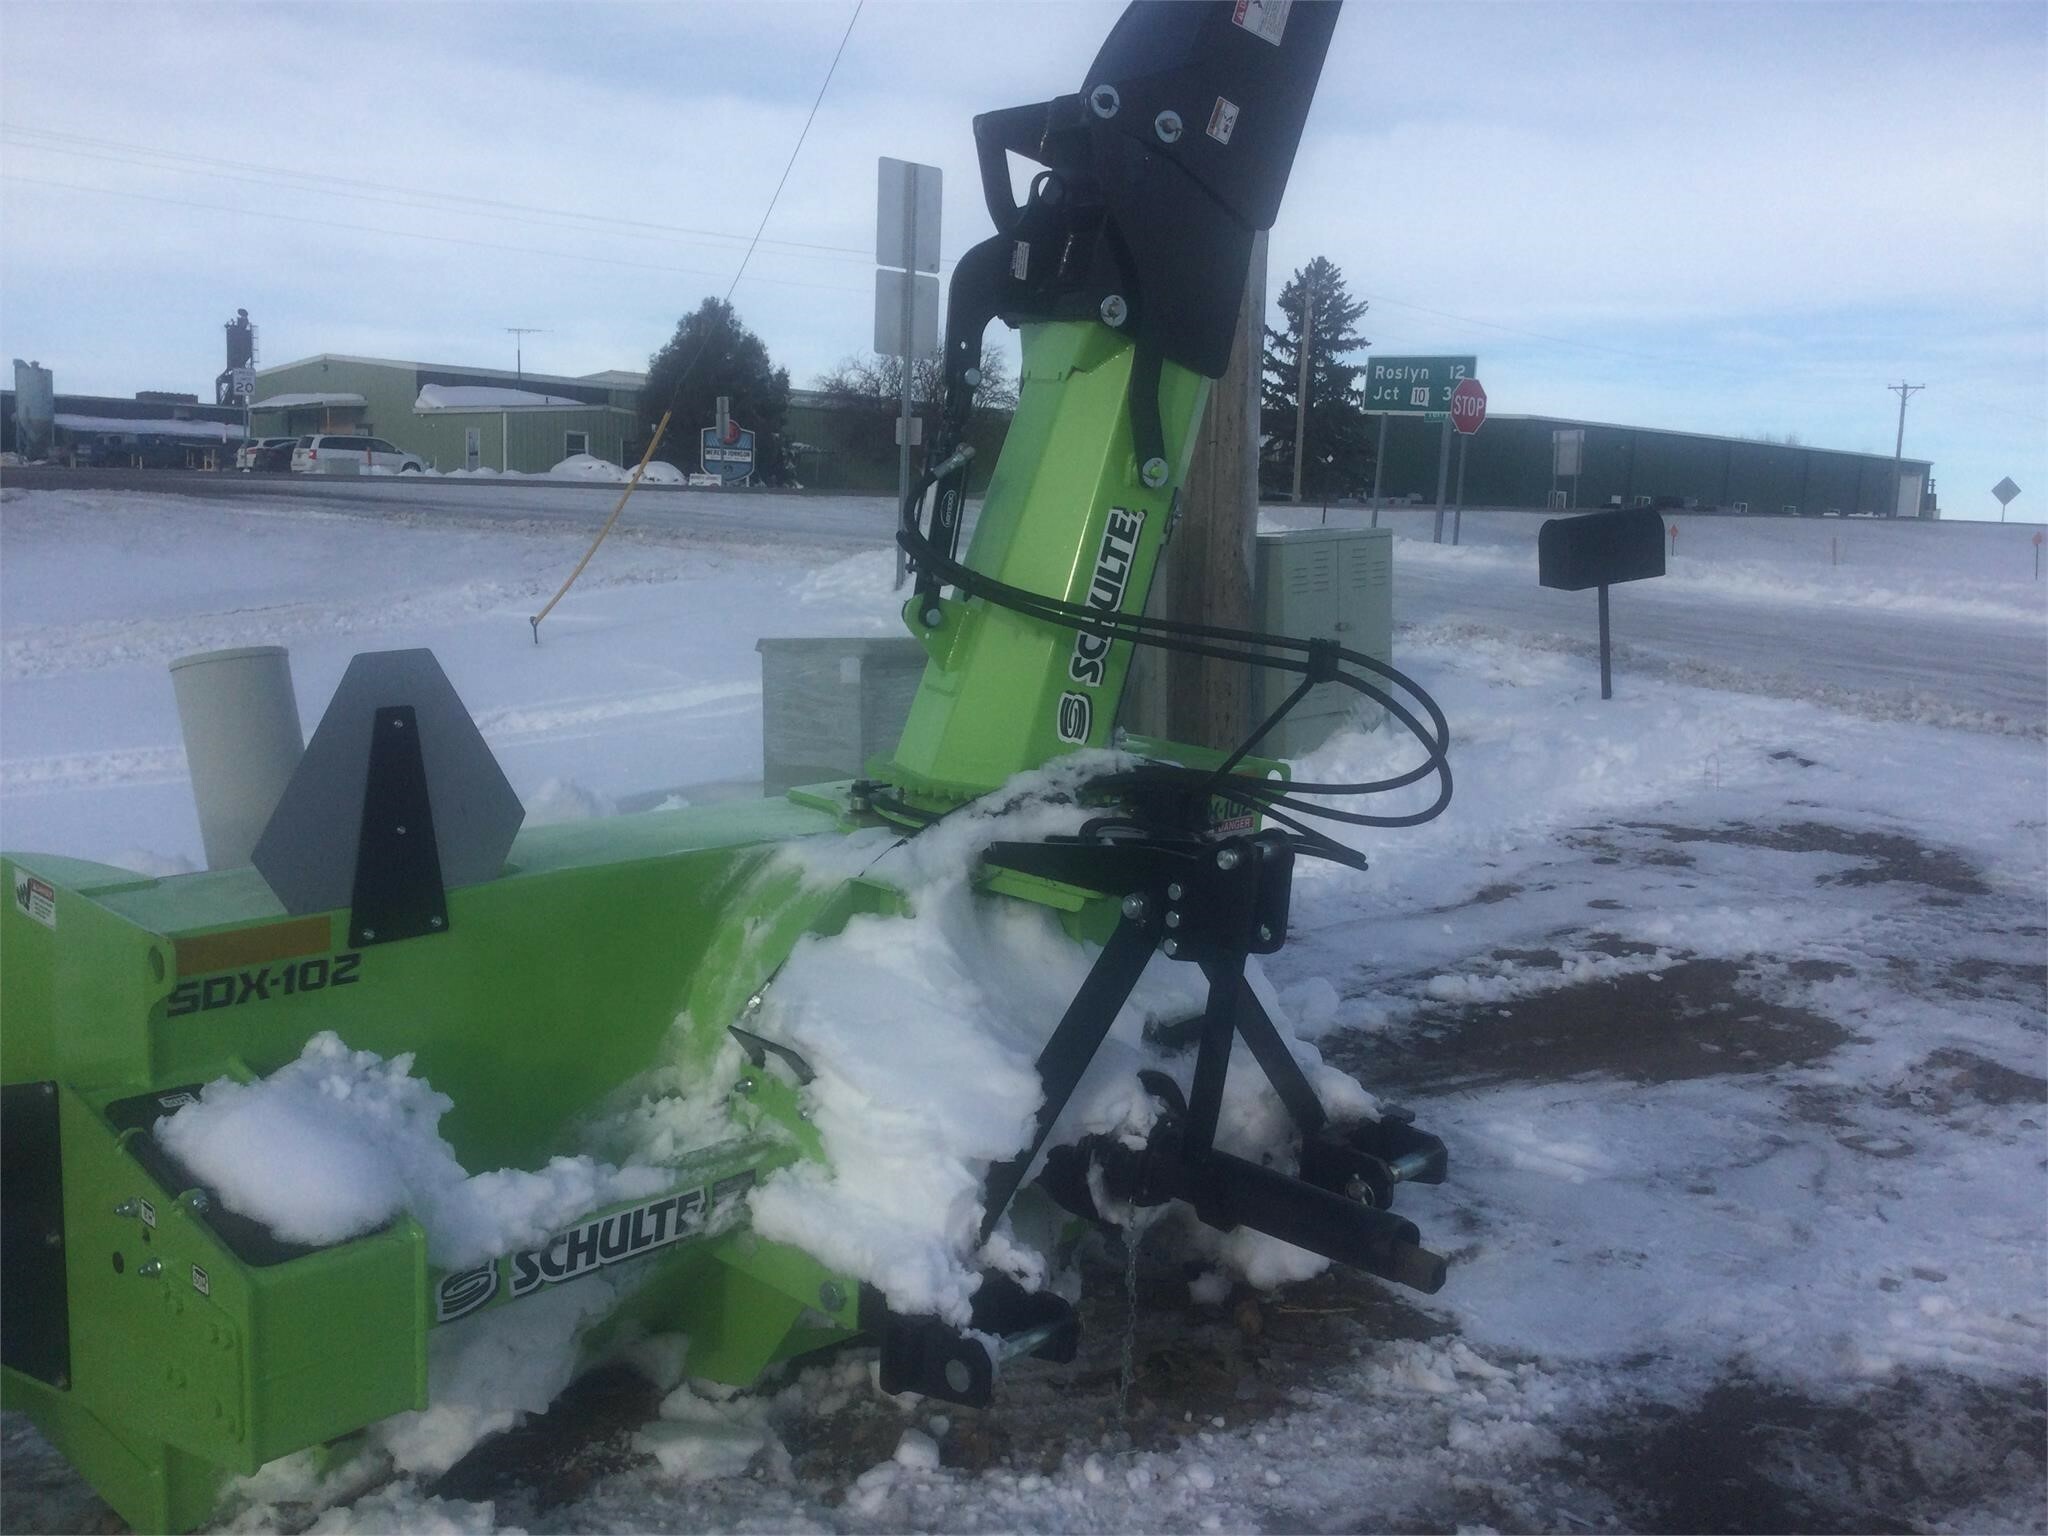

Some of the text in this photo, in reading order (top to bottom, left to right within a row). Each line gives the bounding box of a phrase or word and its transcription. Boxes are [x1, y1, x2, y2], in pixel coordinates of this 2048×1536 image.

[1375, 365, 1466, 383] Roslyn 12
[236, 382, 254, 393] 20
[1373, 386, 1400, 400] Jct
[1414, 388, 1426, 403] 10
[1453, 395, 1485, 417] STOP
[1070, 510, 1141, 686] SCULTE
[167, 952, 362, 1018] SDX-102
